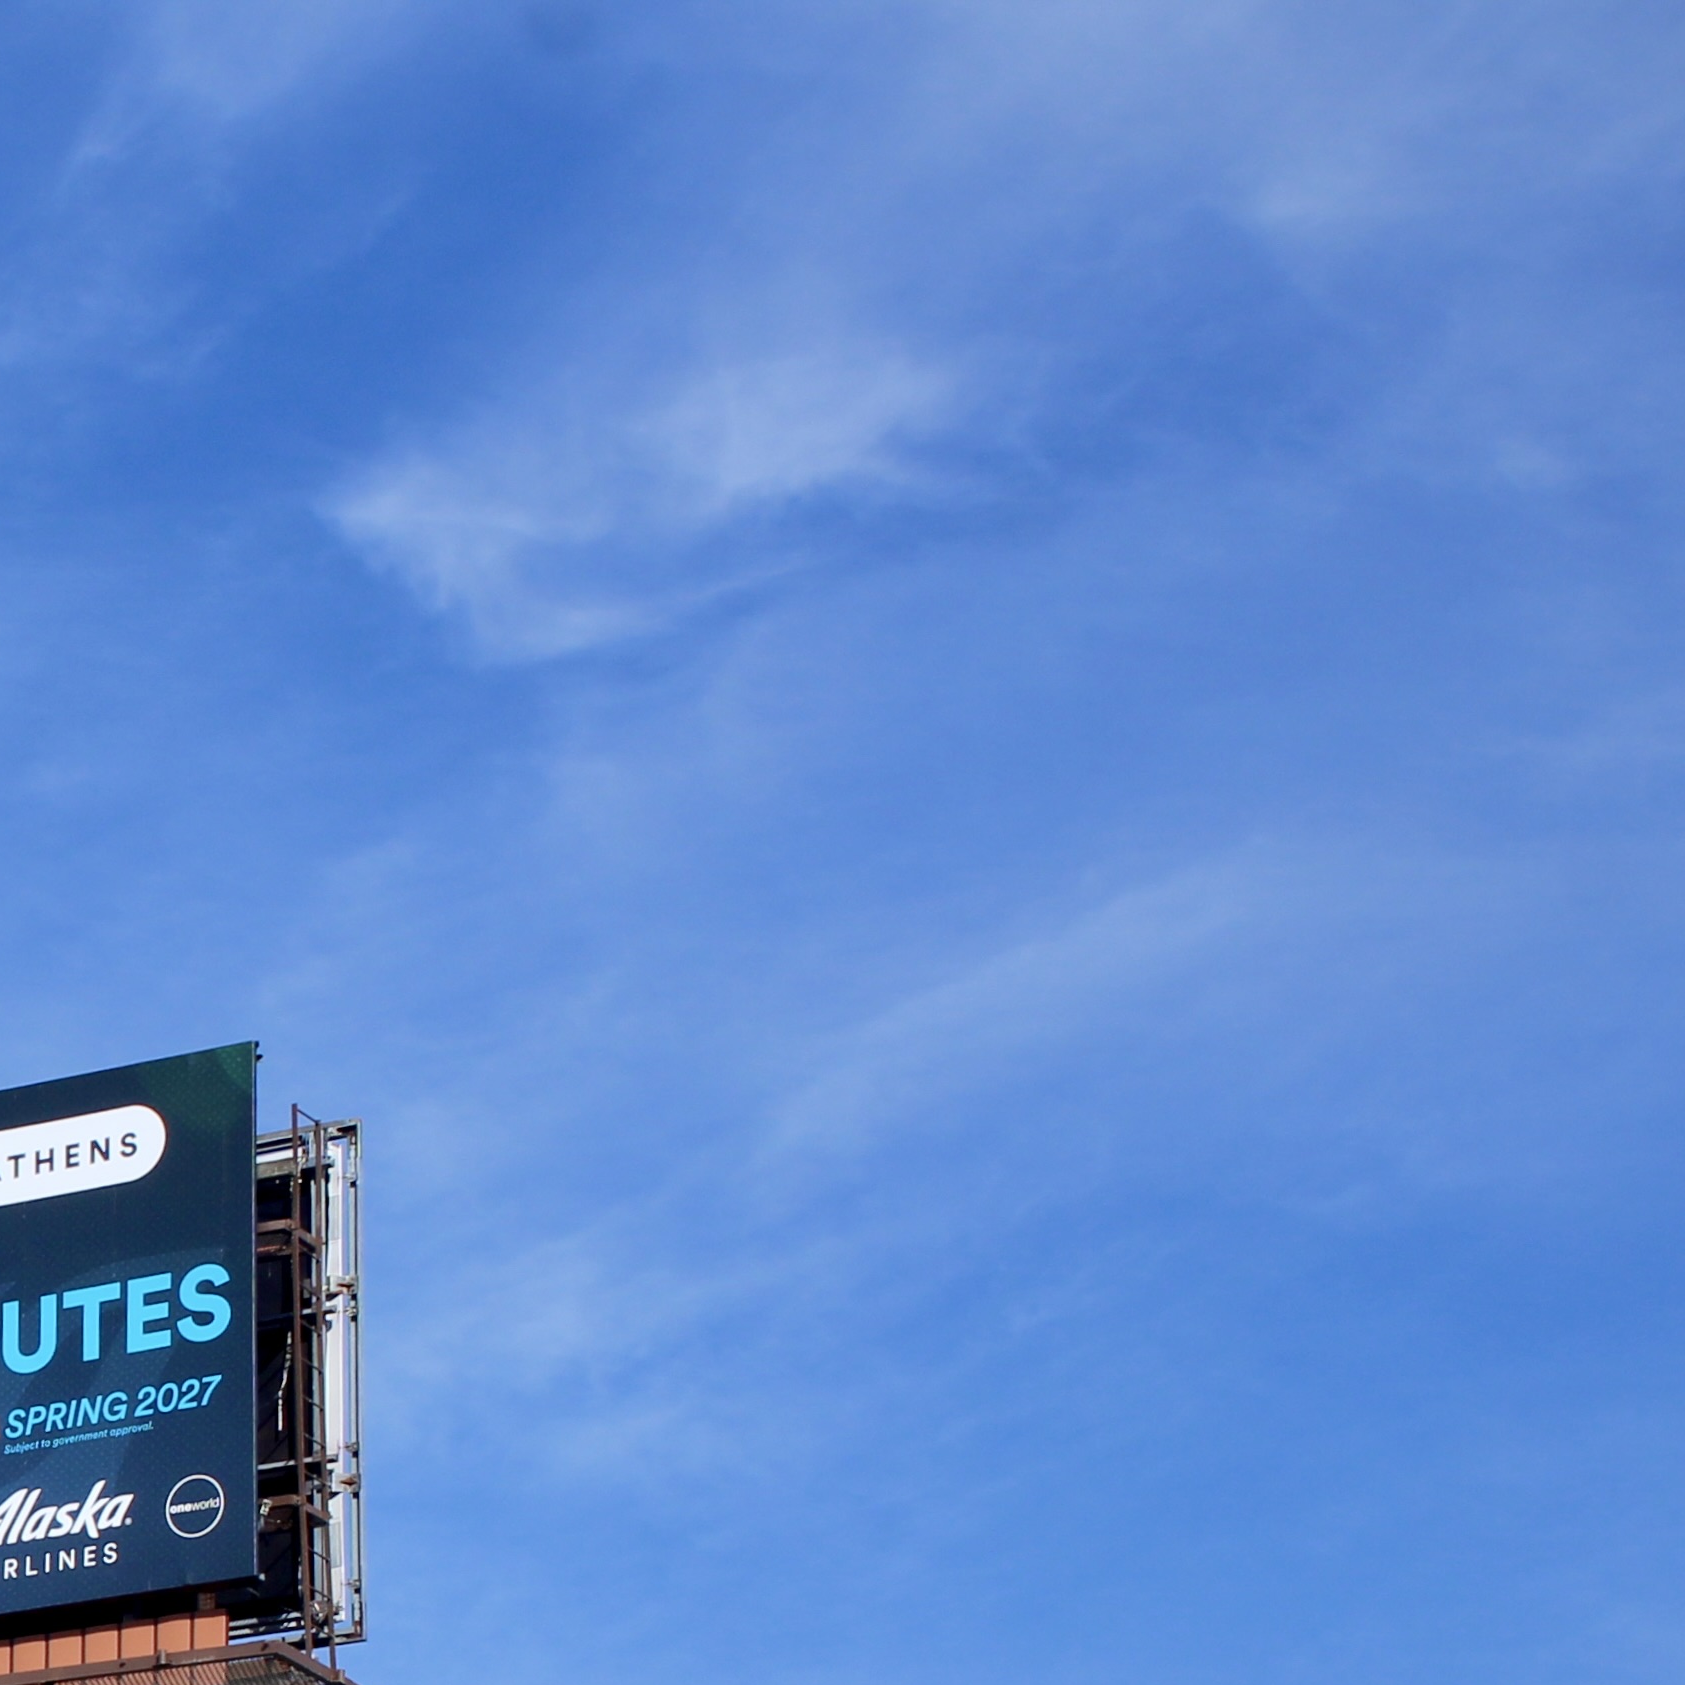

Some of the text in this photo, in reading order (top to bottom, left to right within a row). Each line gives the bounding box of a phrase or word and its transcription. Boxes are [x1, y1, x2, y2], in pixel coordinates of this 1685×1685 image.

[4, 1391, 128, 1439] SPRING
[134, 1374, 222, 1418] 2027
[4, 1439, 39, 1455] Subject
[40, 1439, 51, 1449] to
[52, 1428, 108, 1449] government
[169, 1496, 220, 1515] oneworld
